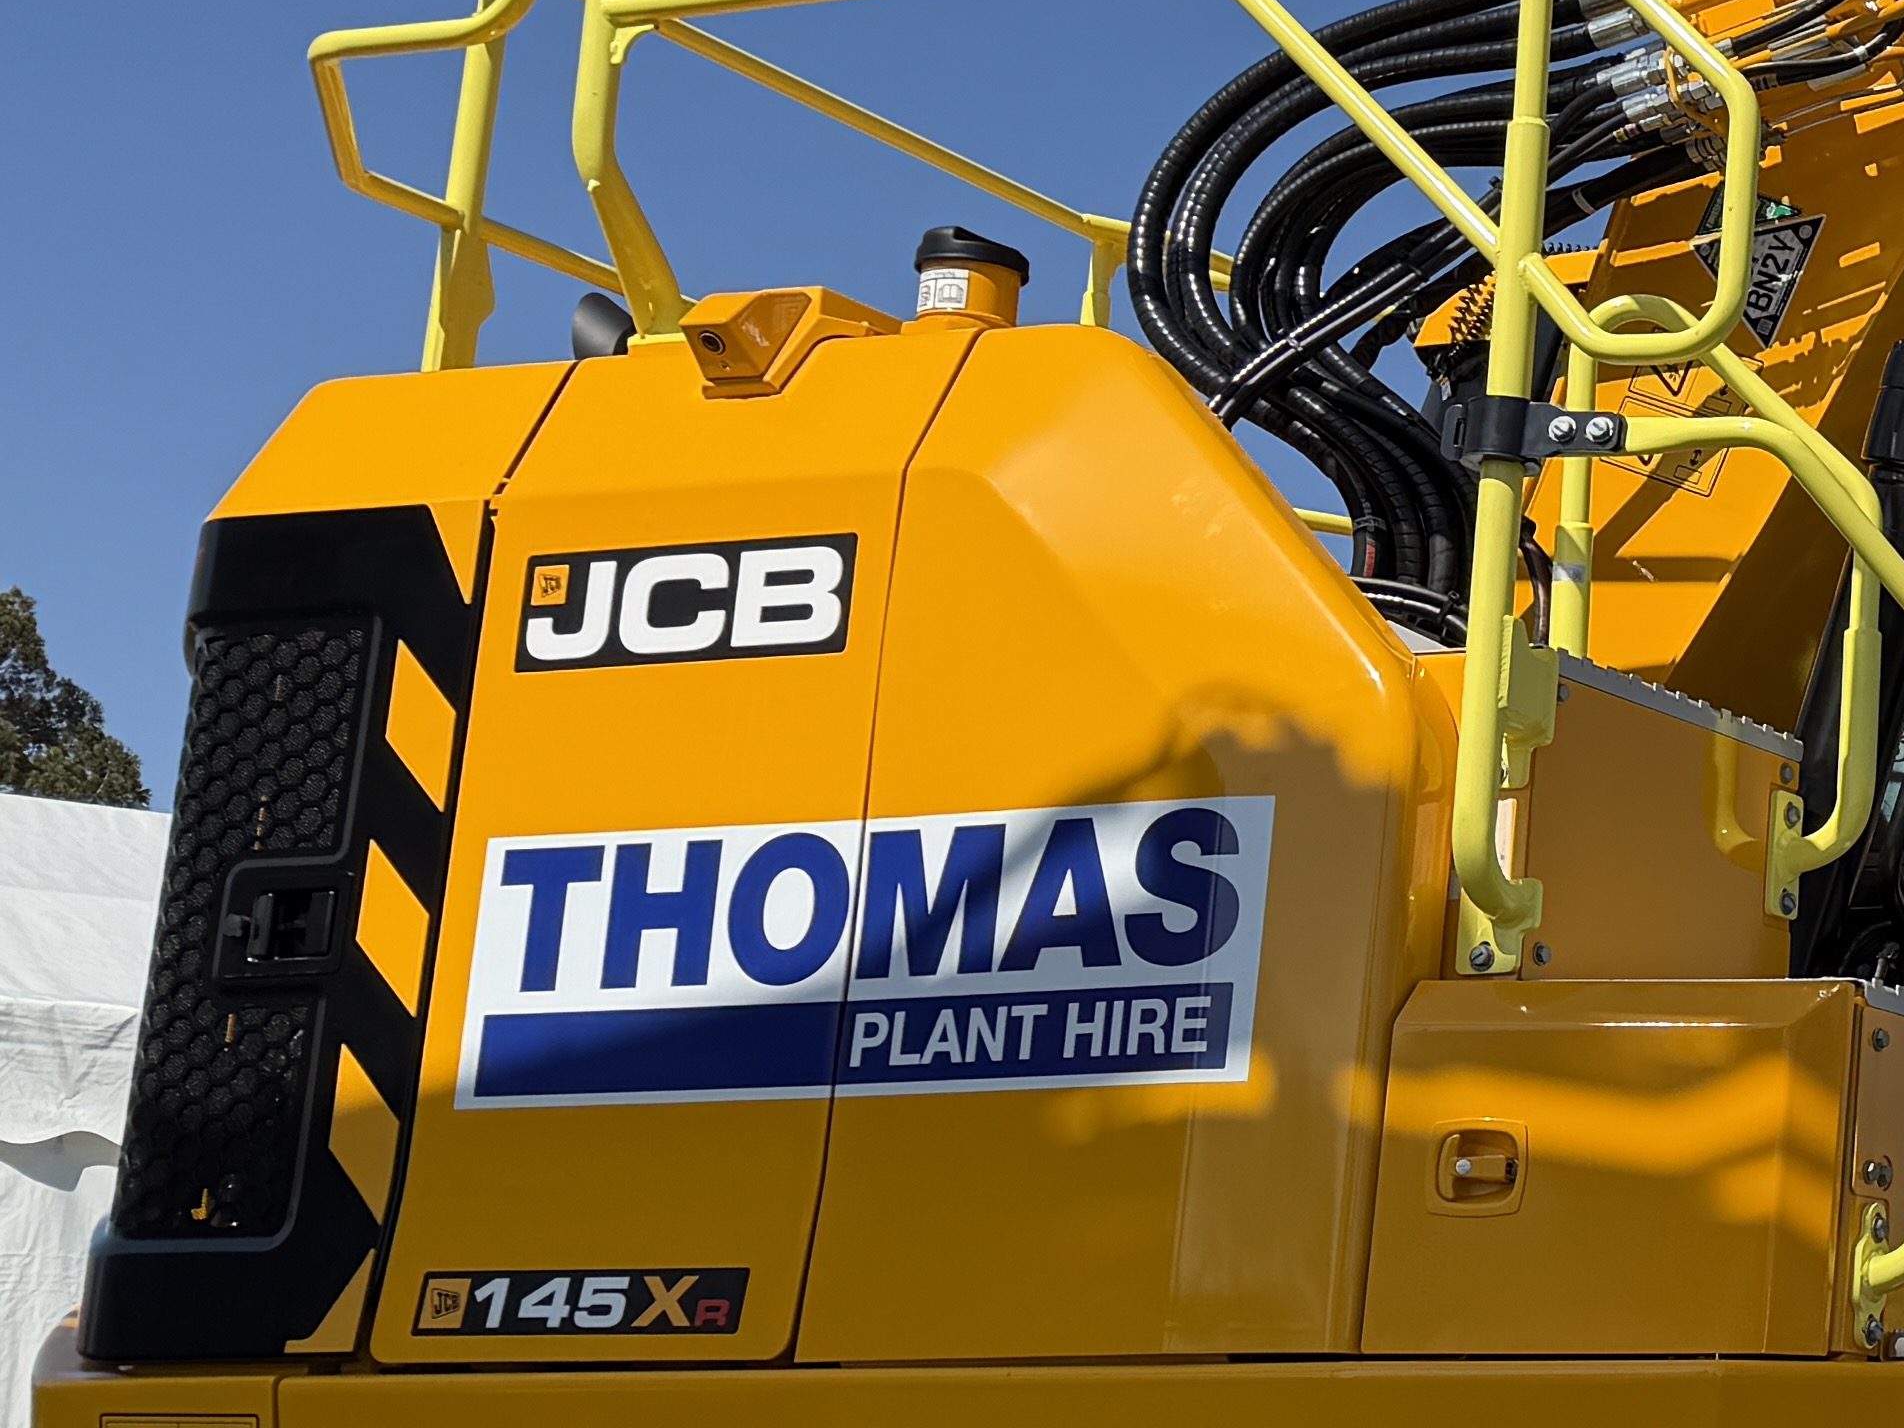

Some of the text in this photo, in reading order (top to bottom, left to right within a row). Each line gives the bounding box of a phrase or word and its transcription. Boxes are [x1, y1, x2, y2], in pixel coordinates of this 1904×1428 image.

[1747, 233, 1796, 312] BN2Y
[526, 546, 843, 661] JCB
[500, 807, 1241, 993] THOMAS
[848, 995, 1211, 1068] PLANT HIRE
